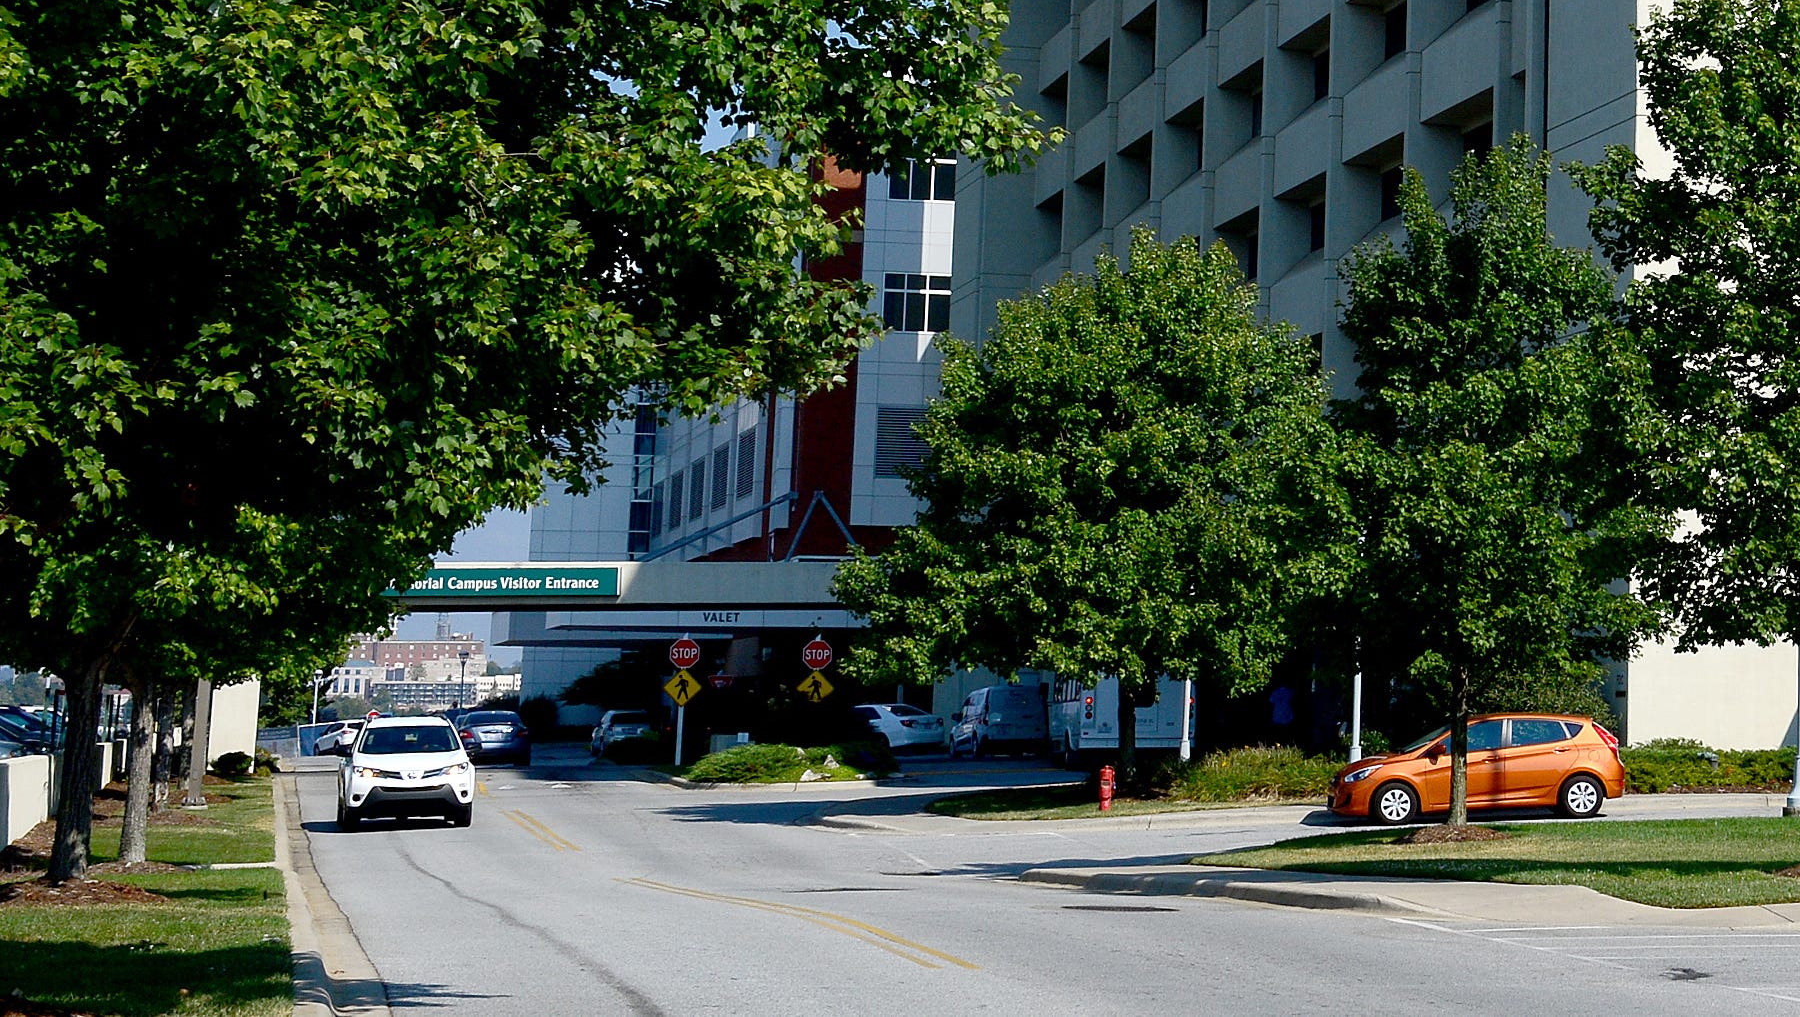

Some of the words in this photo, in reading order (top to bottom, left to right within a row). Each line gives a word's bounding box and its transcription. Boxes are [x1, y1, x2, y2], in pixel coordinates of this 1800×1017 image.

[447, 577, 498, 592] Campus
[500, 576, 541, 590] Visitor
[545, 577, 599, 589] Entrance
[703, 612, 741, 623] VALET
[672, 647, 698, 659] STOP
[805, 649, 831, 660] STOP
